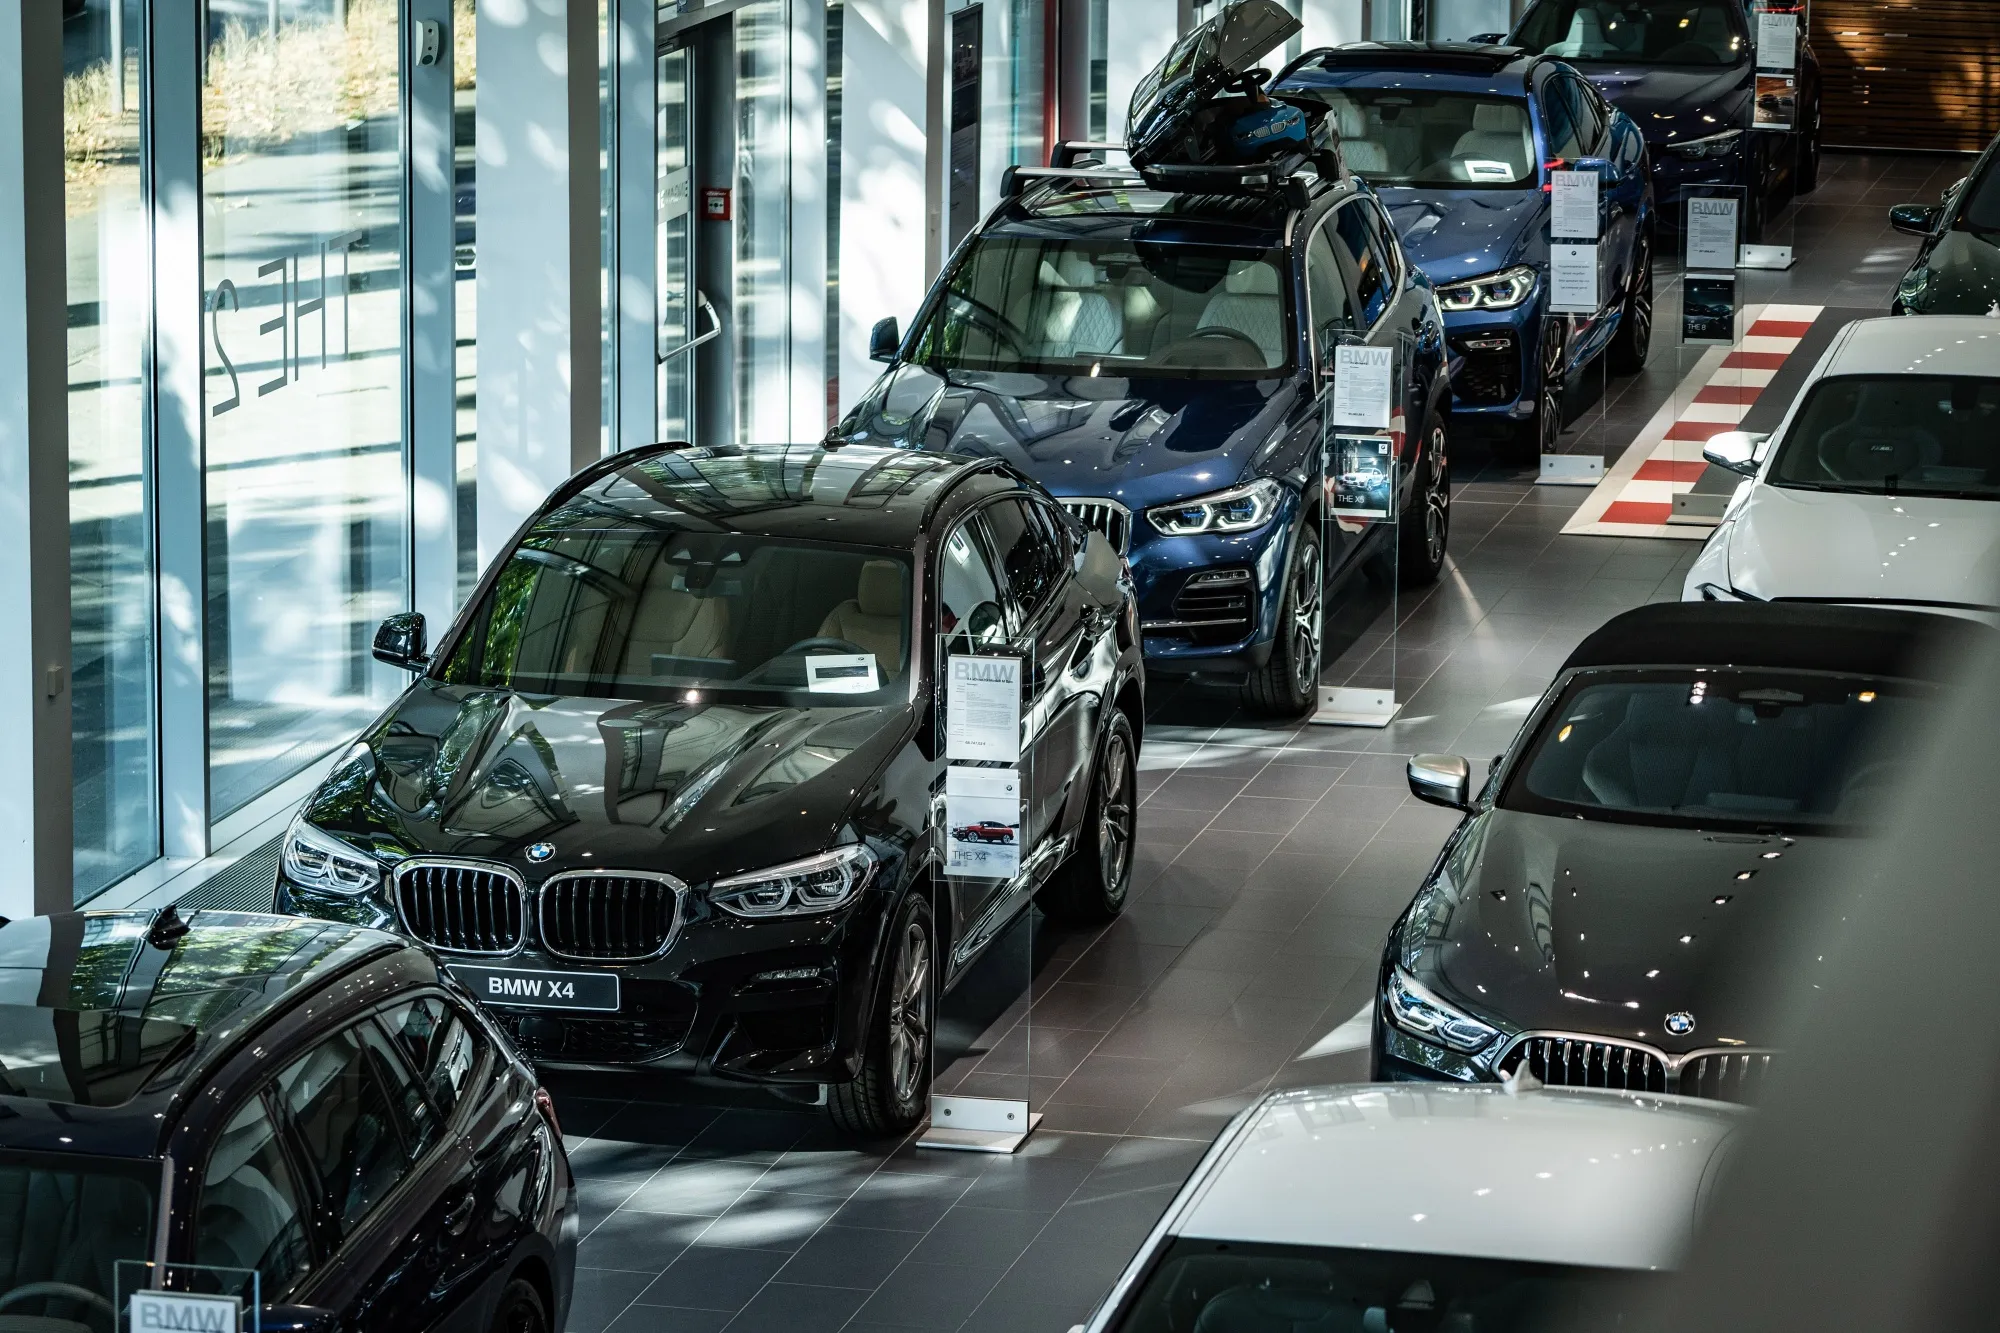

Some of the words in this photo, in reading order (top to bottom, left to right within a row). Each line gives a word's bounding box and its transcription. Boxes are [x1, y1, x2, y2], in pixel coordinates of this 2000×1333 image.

[1761, 15, 1796, 27] BMW
[1555, 174, 1596, 188] BMW
[1691, 201, 1735, 215] BMW
[1687, 323, 1701, 331] THE
[1701, 324, 1707, 332] 8
[1340, 348, 1390, 366] BMW
[1337, 494, 1354, 503] THE
[954, 661, 1015, 682] BMW
[952, 850, 973, 861] THE
[974, 852, 987, 861] X4
[488, 976, 543, 997] BMW
[547, 980, 576, 999] X4
[140, 1301, 228, 1333] BMW
